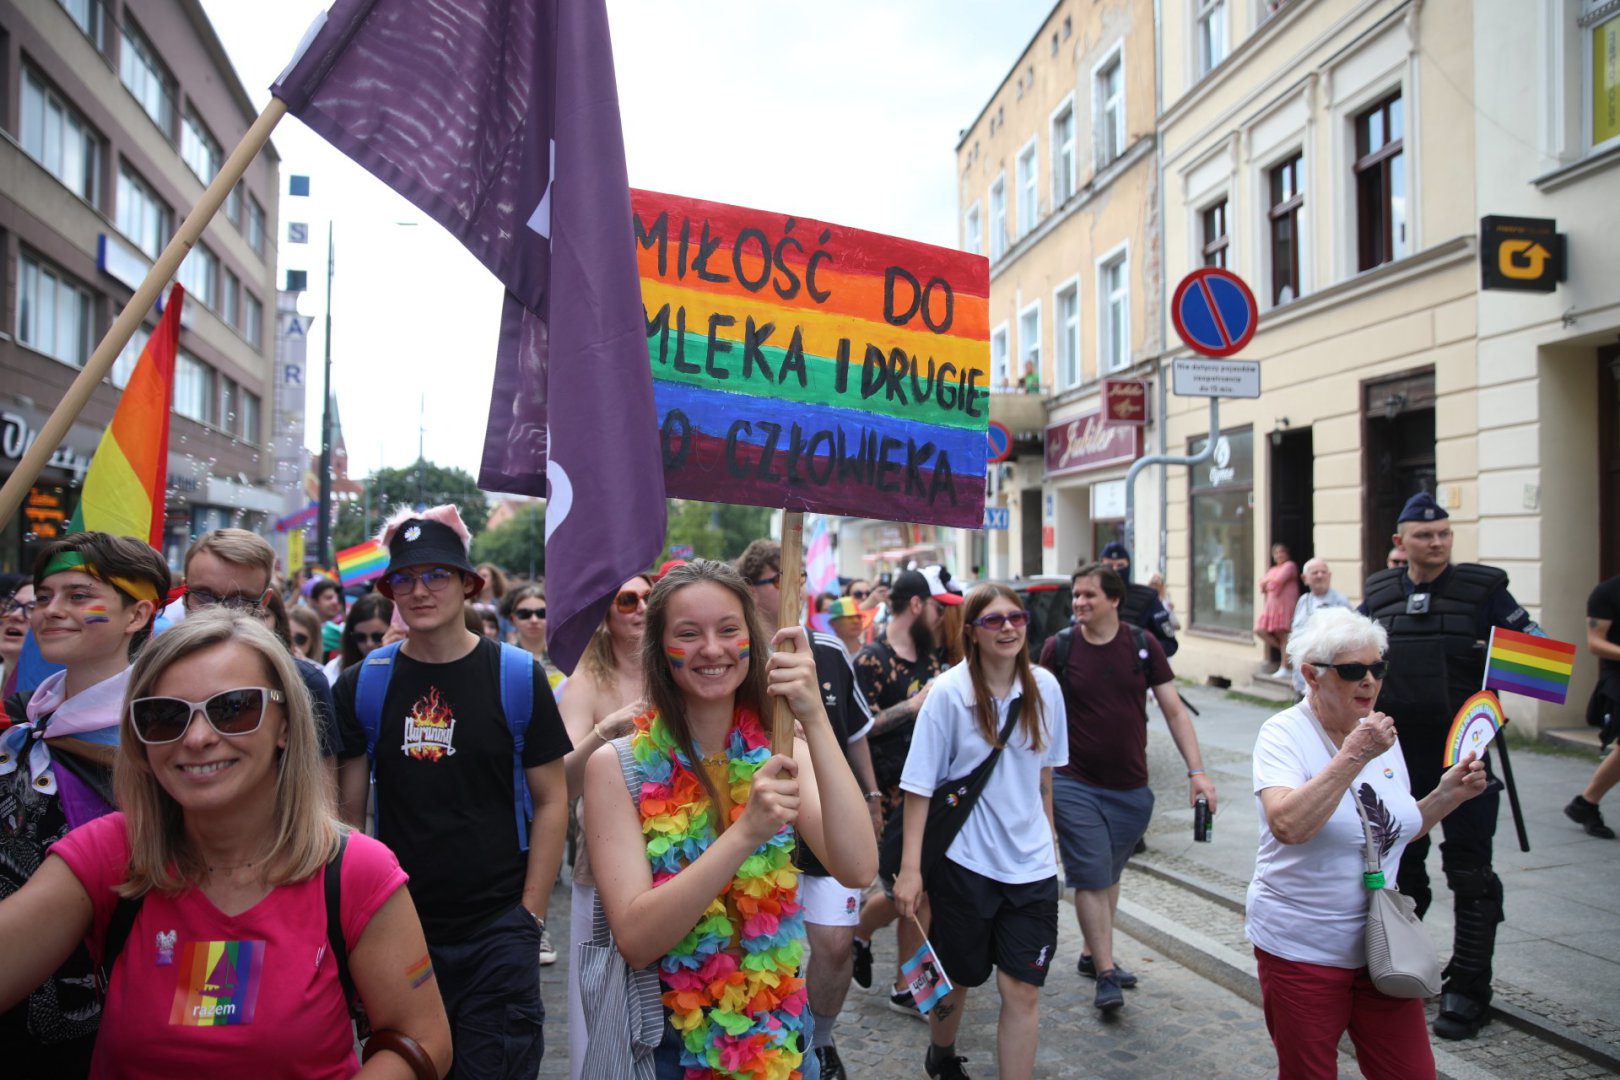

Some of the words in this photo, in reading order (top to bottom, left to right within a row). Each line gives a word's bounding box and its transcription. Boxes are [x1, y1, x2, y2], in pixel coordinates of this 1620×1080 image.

[634, 210, 832, 303] MIŁOŚĆ
[884, 266, 954, 334] DO
[642, 303, 808, 388] MLEKA
[835, 338, 851, 394] I
[661, 407, 691, 470] O
[727, 419, 957, 506] CZŁOWIEKA
[983, 508, 1007, 527] AXI
[192, 1003, 236, 1017] razem
